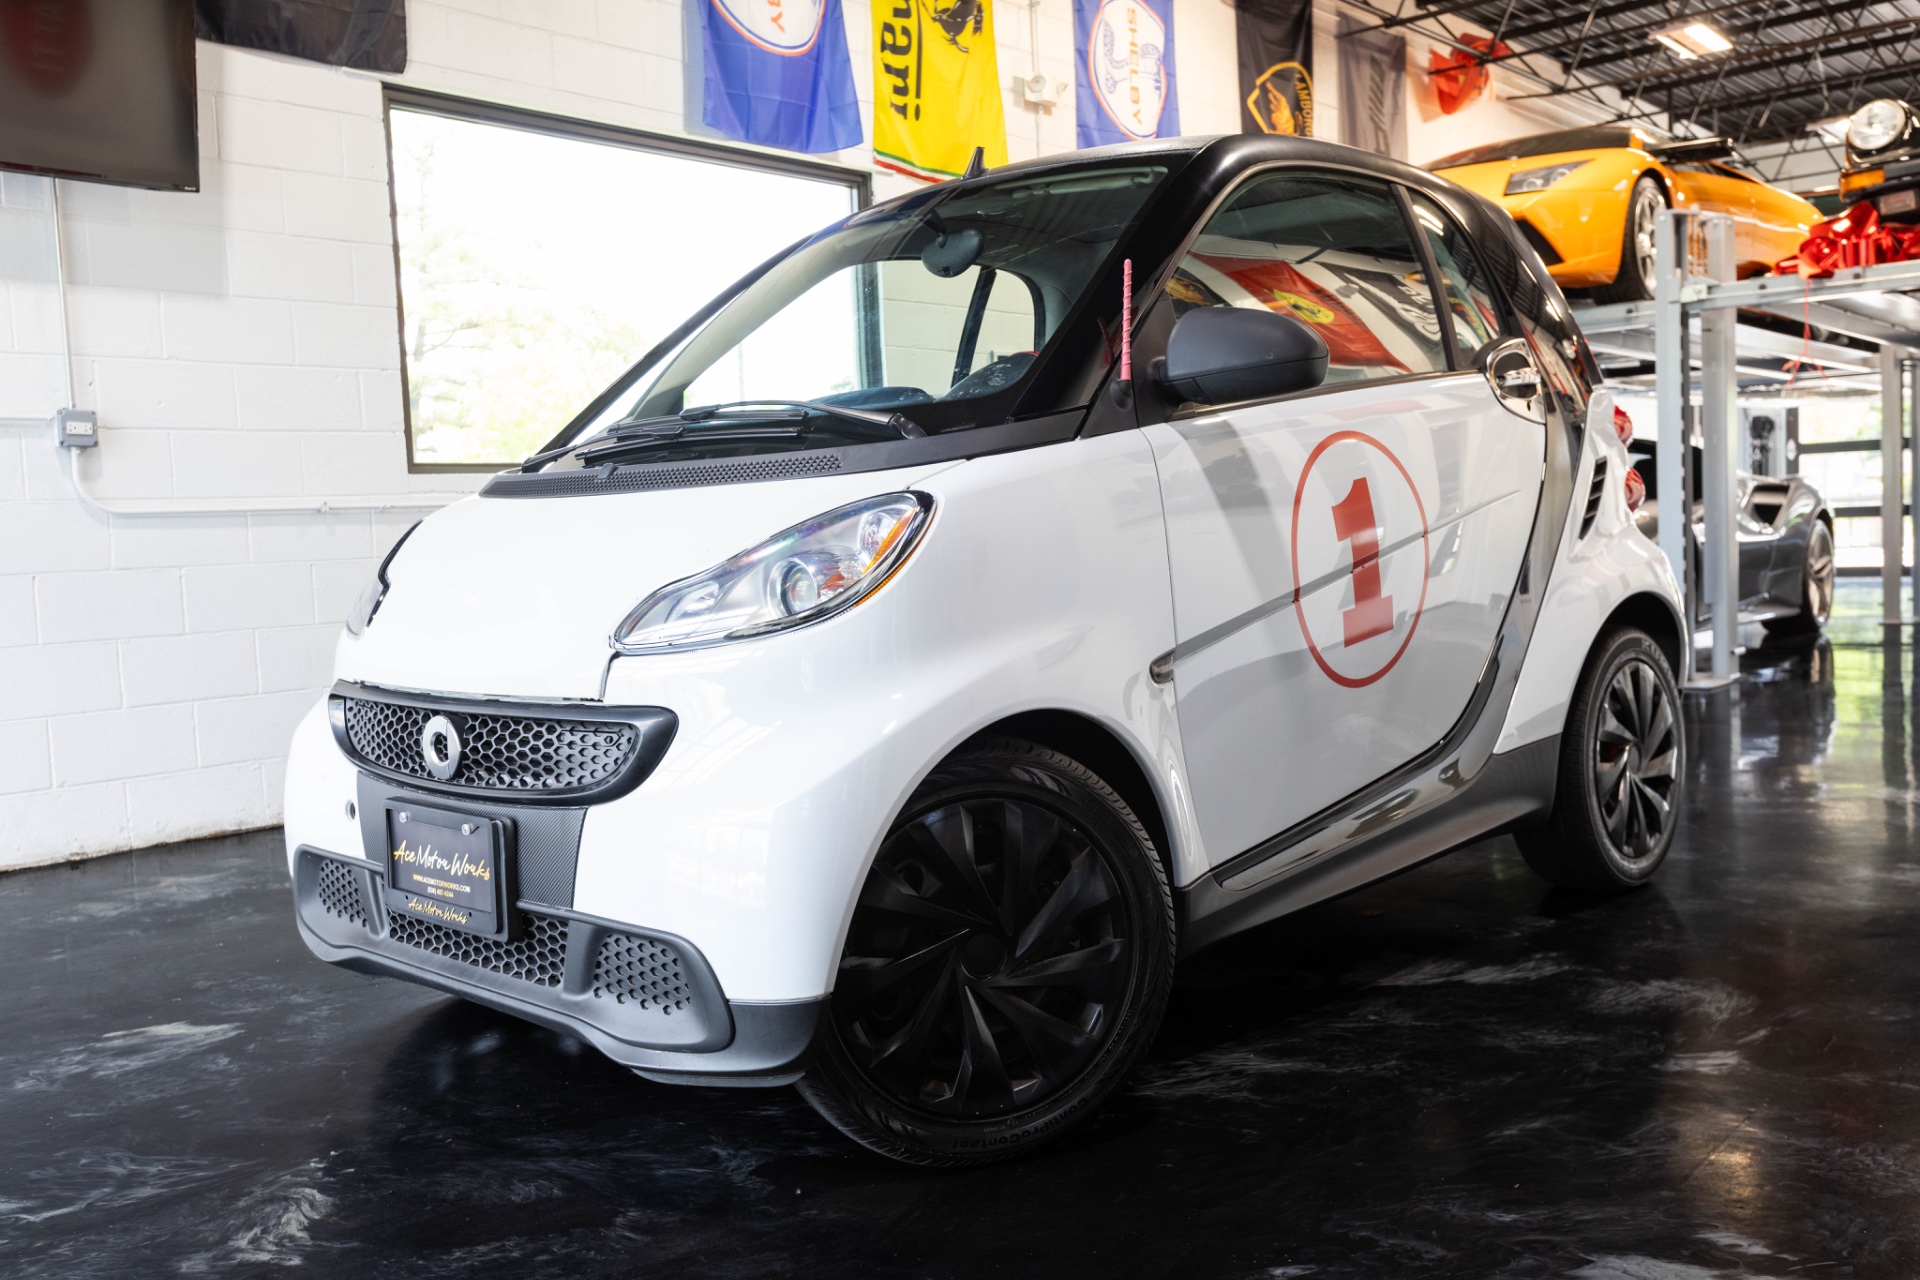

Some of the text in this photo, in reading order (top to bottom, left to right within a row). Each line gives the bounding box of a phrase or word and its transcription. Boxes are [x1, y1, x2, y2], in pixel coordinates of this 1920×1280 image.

[1127, 8, 1142, 125] SHELBY
[1331, 477, 1394, 648] 1
[394, 840, 490, 880] Ace Motor Works
[408, 897, 467, 924] Ace Motor Works
